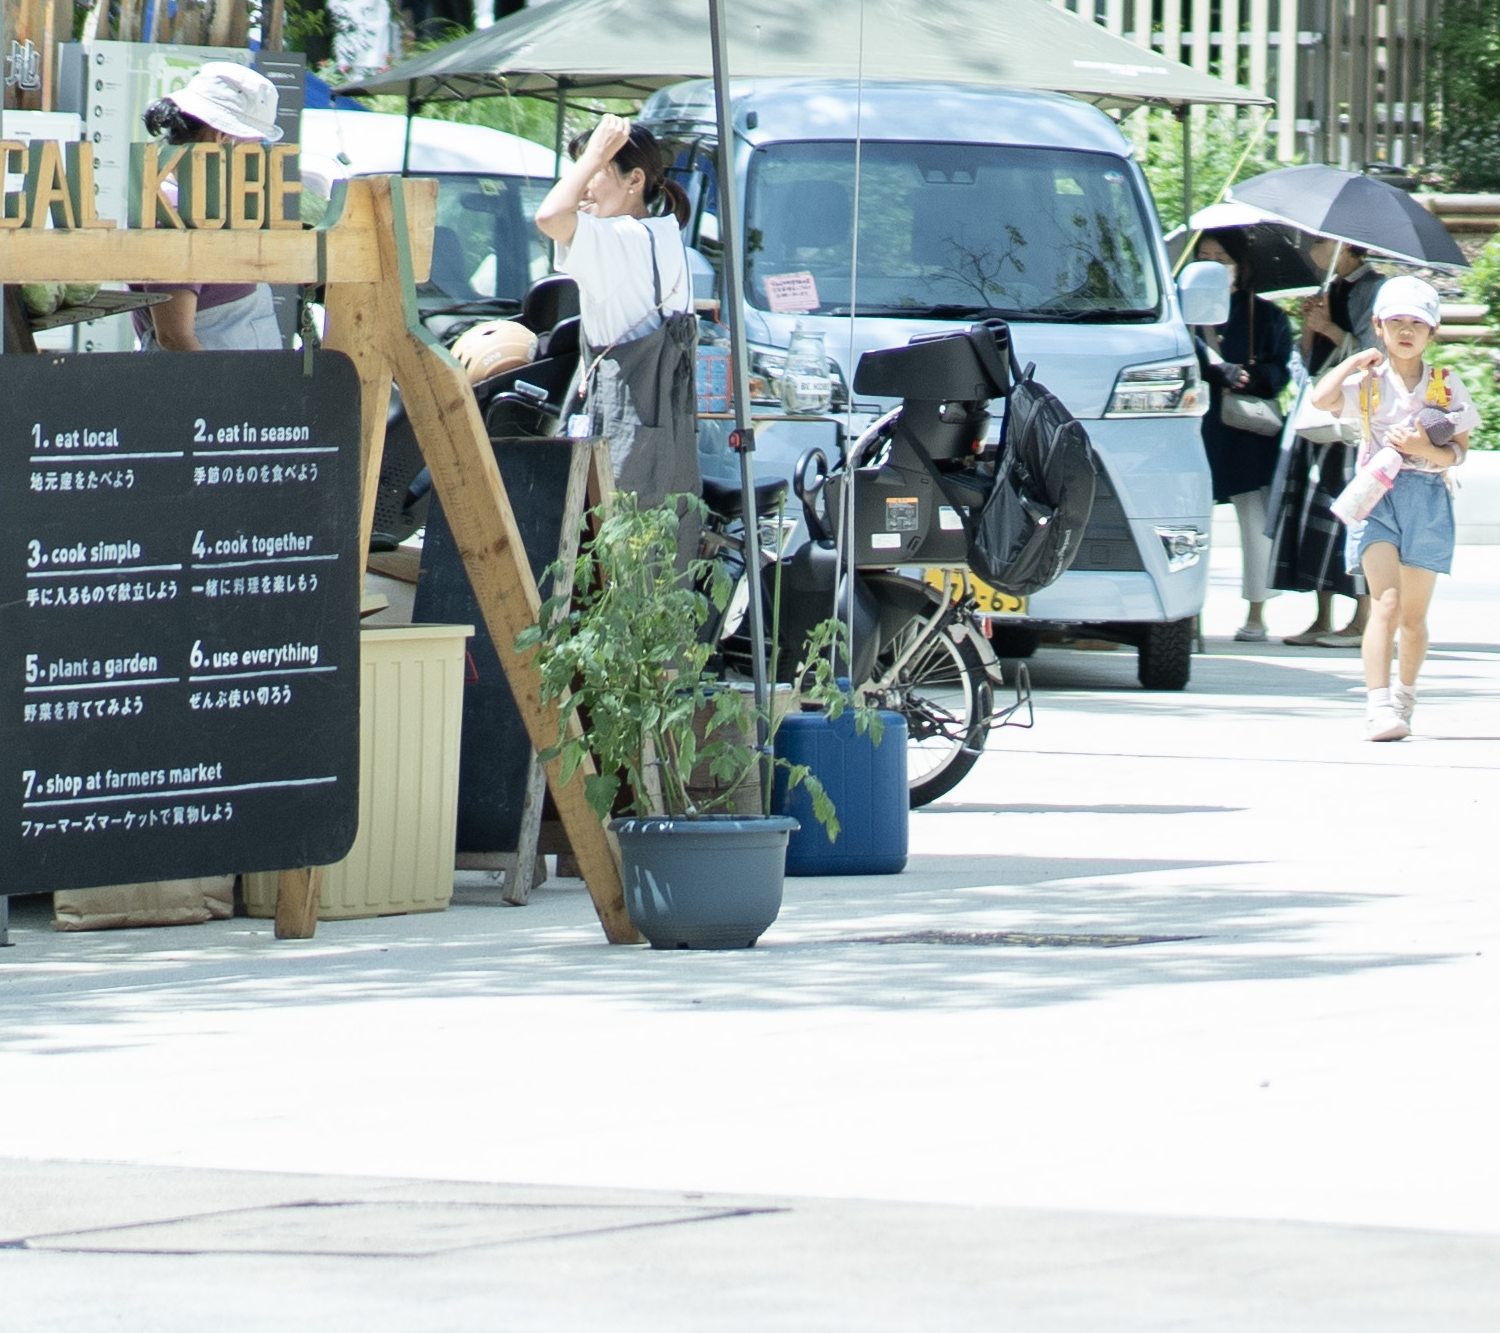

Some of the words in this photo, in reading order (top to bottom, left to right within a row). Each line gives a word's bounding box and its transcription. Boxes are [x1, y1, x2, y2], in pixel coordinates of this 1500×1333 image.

[142, 141, 304, 231] KOBE
[31, 423, 50, 448] 1.
[55, 430, 80, 448] eat
[83, 428, 119, 447] local
[193, 418, 214, 443] 2.
[216, 424, 241, 443] eat
[243, 421, 257, 443] in
[260, 425, 310, 442] season
[29, 469, 135, 491] 地元産をたべよう
[193, 463, 318, 485] 季節のものを食べよう
[27, 539, 49, 568] 3.
[51, 542, 87, 563] cook
[90, 539, 141, 564] simple
[191, 530, 213, 559] 4.
[215, 534, 248, 554] cook
[252, 531, 314, 556] together
[26, 580, 177, 607] 手に入るもので献立しよう
[191, 573, 318, 597] 一緒に料理を楽しもう
[189, 639, 210, 668] 6.
[212, 651, 239, 668] use
[241, 642, 319, 666] everything
[25, 653, 46, 683] 5.
[49, 658, 88, 682] plant
[92, 660, 100, 676] a
[104, 652, 158, 679] garden
[24, 695, 144, 722] 野菜を育ててみよう
[189, 684, 292, 710] ぜんぶ使い切ろう
[22, 770, 44, 799] 7.
[46, 773, 82, 796] shop
[85, 771, 101, 790] at
[105, 769, 166, 788] farmers
[169, 762, 223, 783] market
[21, 802, 233, 836] ファーマーズマーケットで買物しよう
